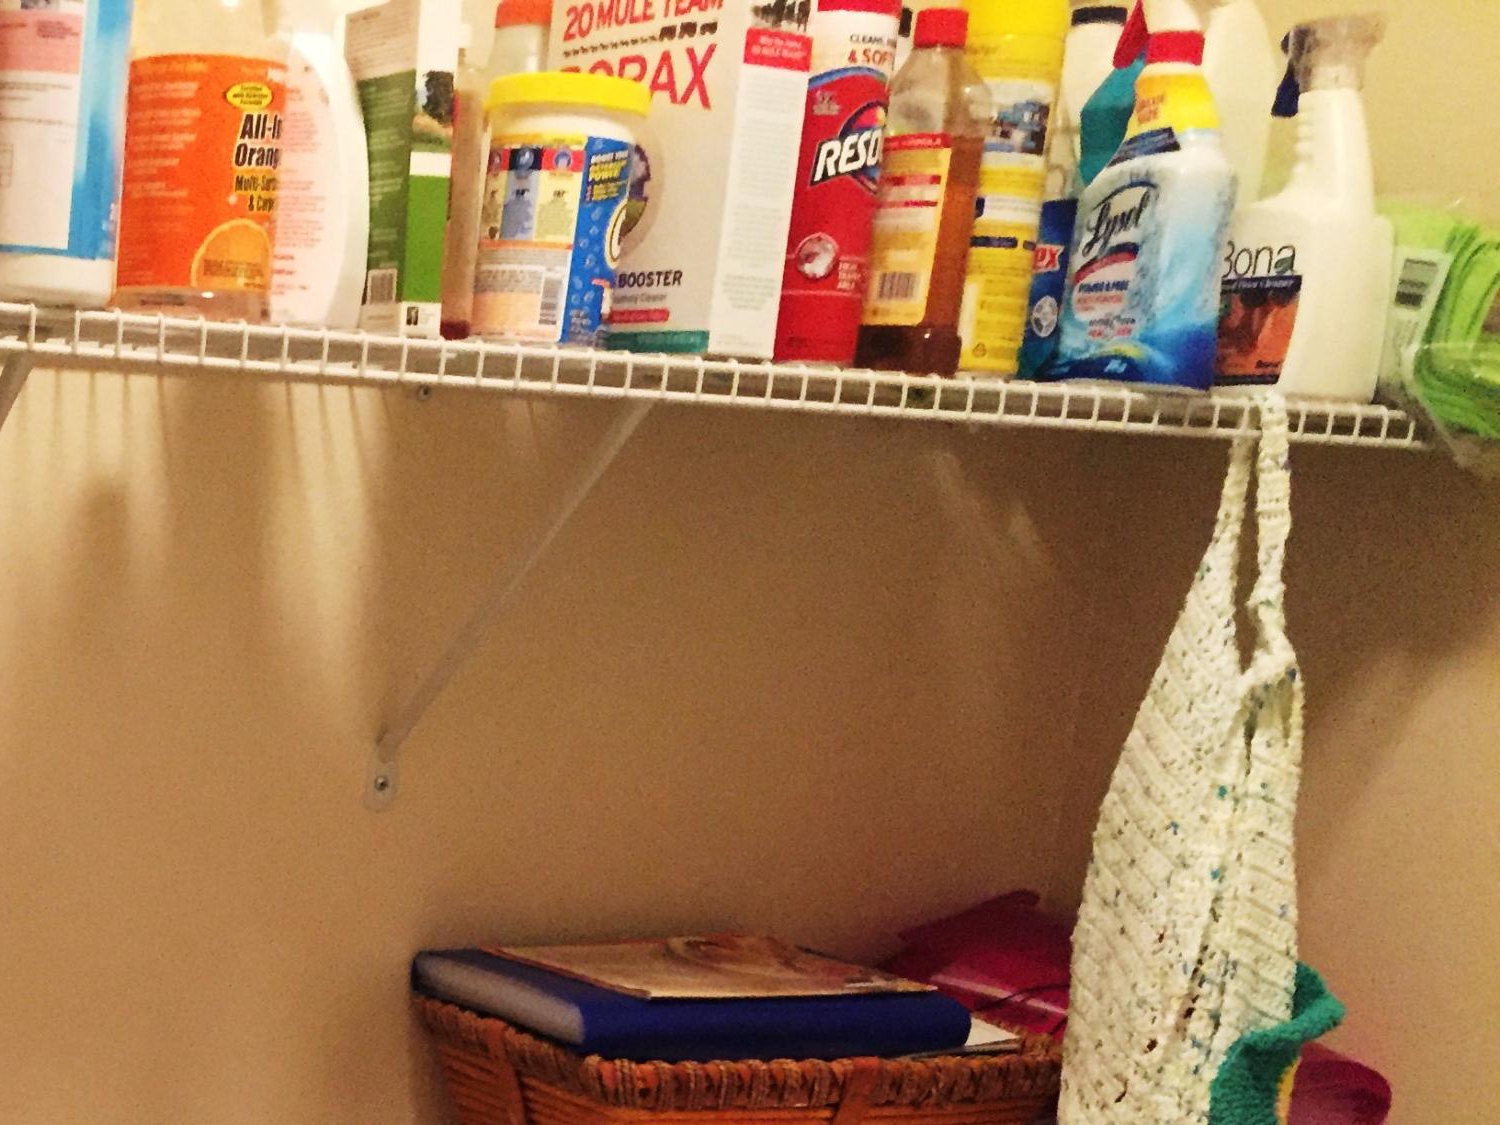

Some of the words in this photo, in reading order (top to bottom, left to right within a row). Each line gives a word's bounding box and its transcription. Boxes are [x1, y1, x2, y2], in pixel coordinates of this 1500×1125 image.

[563, 3, 595, 42] 20
[596, 0, 655, 29] MULE
[862, 48, 892, 66] SOF
[560, 43, 717, 111] RAX
[233, 143, 283, 170] Orang
[812, 129, 883, 183] RESO
[1222, 240, 1297, 278] Bona
[618, 269, 684, 289] BOOSTER
